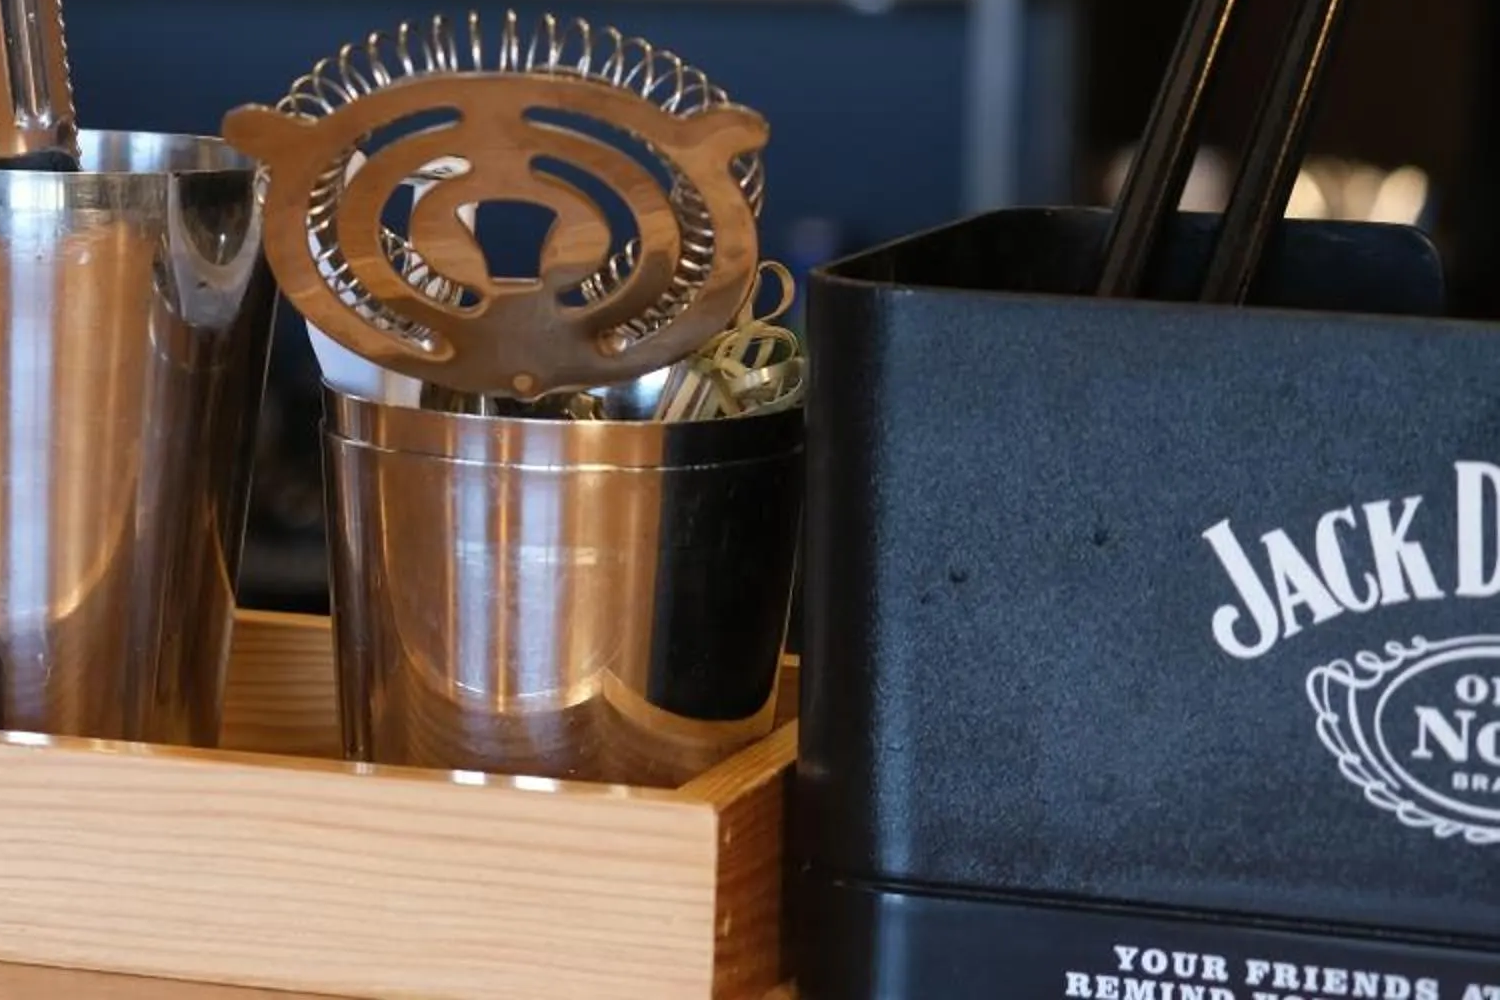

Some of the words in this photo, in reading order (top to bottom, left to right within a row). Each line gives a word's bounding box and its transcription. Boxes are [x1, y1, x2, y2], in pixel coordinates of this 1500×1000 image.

[1200, 494, 1447, 660] JACK
[1064, 971, 1237, 1000] REMIND
[1113, 944, 1230, 983] YOUR
[1245, 959, 1440, 1000] FRIENDS
